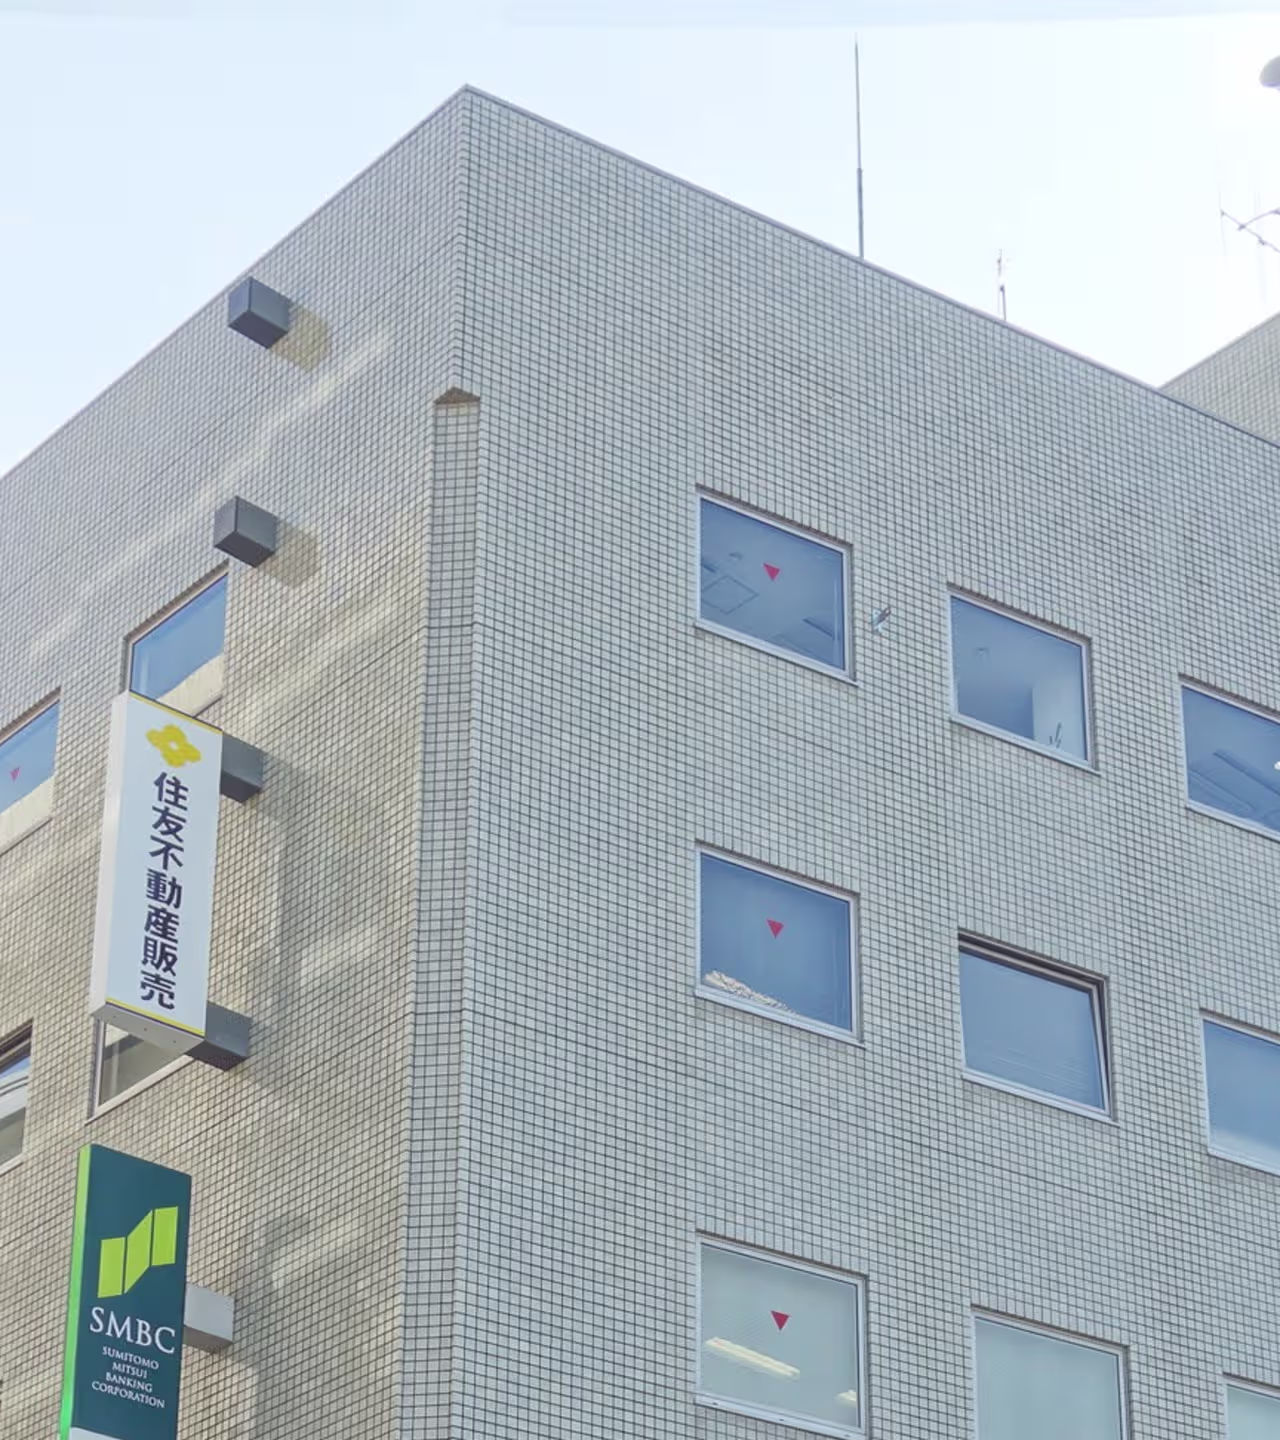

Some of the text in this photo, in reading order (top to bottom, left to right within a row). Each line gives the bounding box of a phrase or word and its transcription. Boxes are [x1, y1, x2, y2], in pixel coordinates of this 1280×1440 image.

[141, 771, 189, 1010] 住友不動産販売
[89, 1306, 176, 1354] SMBC
[102, 1346, 159, 1370] SUMITOMO
[112, 1362, 148, 1379] MITSUI
[91, 1381, 166, 1409] CORPORATION
[105, 1372, 153, 1393] BANKING
